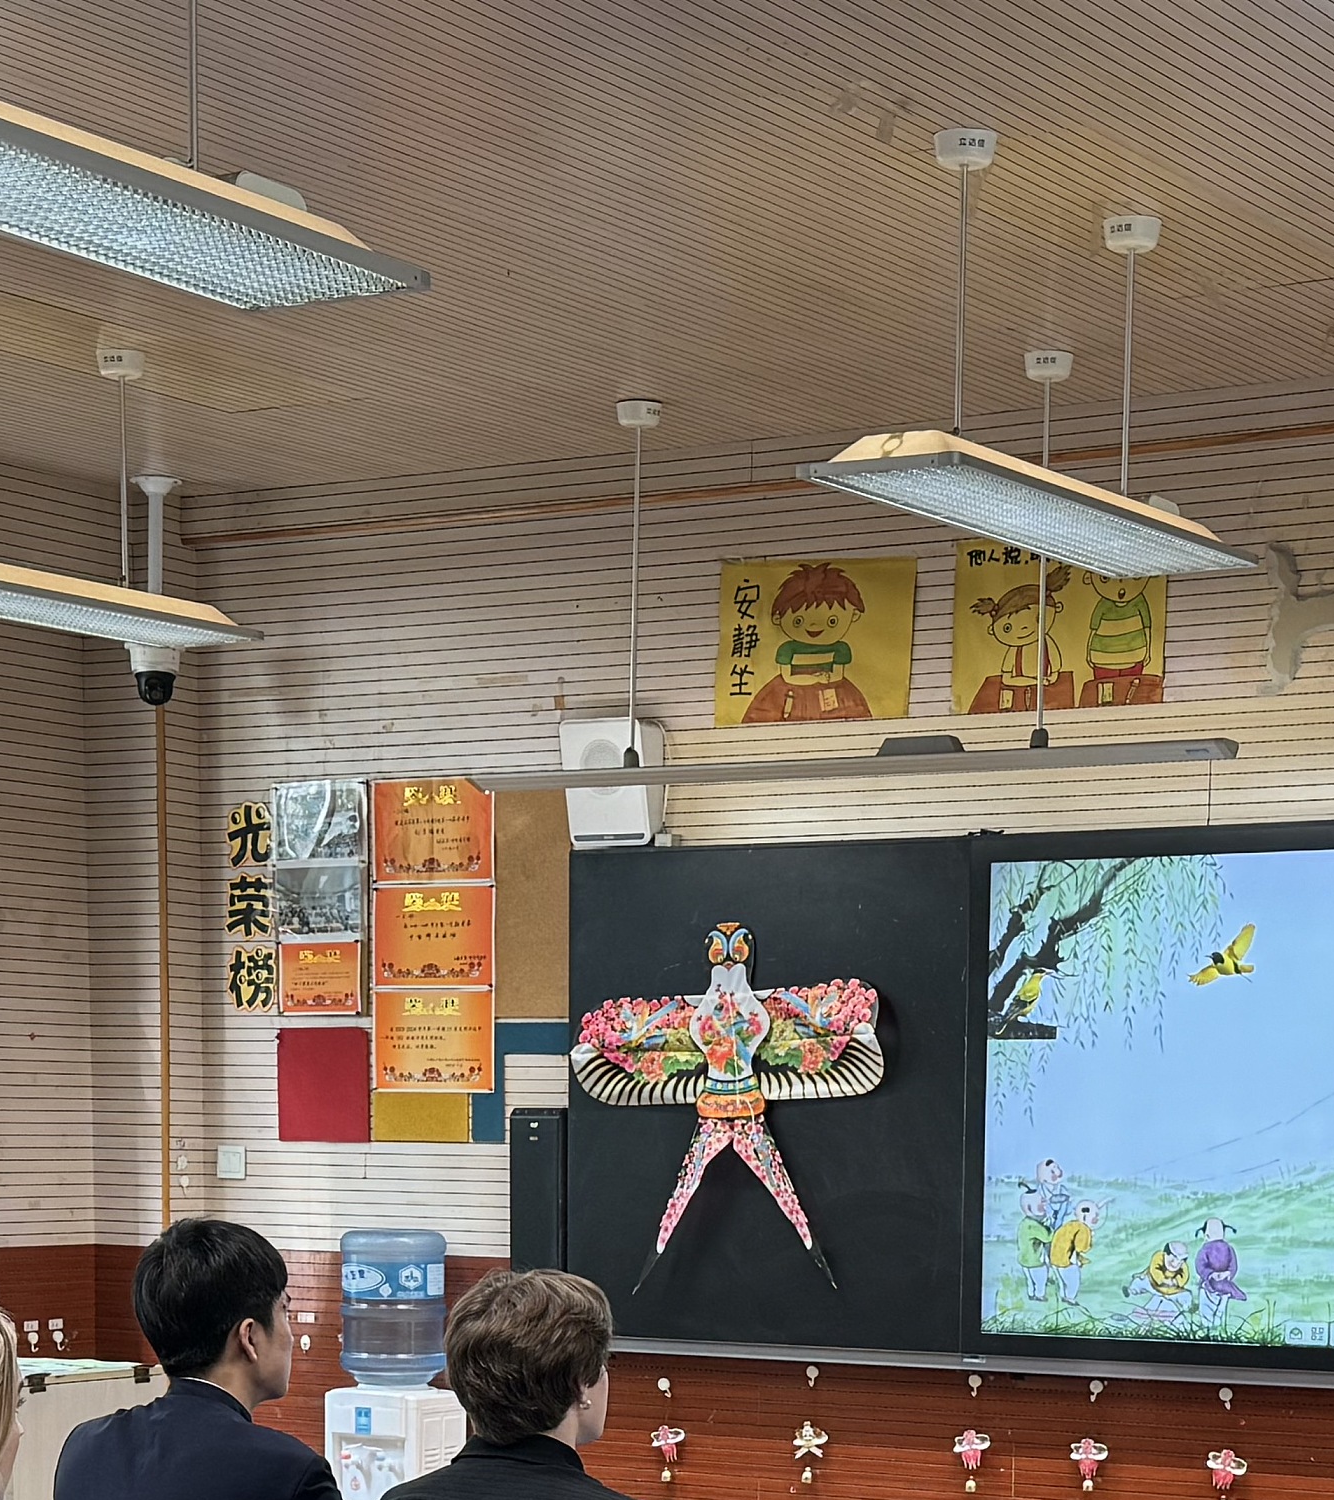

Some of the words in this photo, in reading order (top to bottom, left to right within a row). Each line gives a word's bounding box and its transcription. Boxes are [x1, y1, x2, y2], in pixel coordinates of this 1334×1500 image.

[729, 578, 762, 697] 安静坐
[226, 802, 276, 1011] 光荣榜
